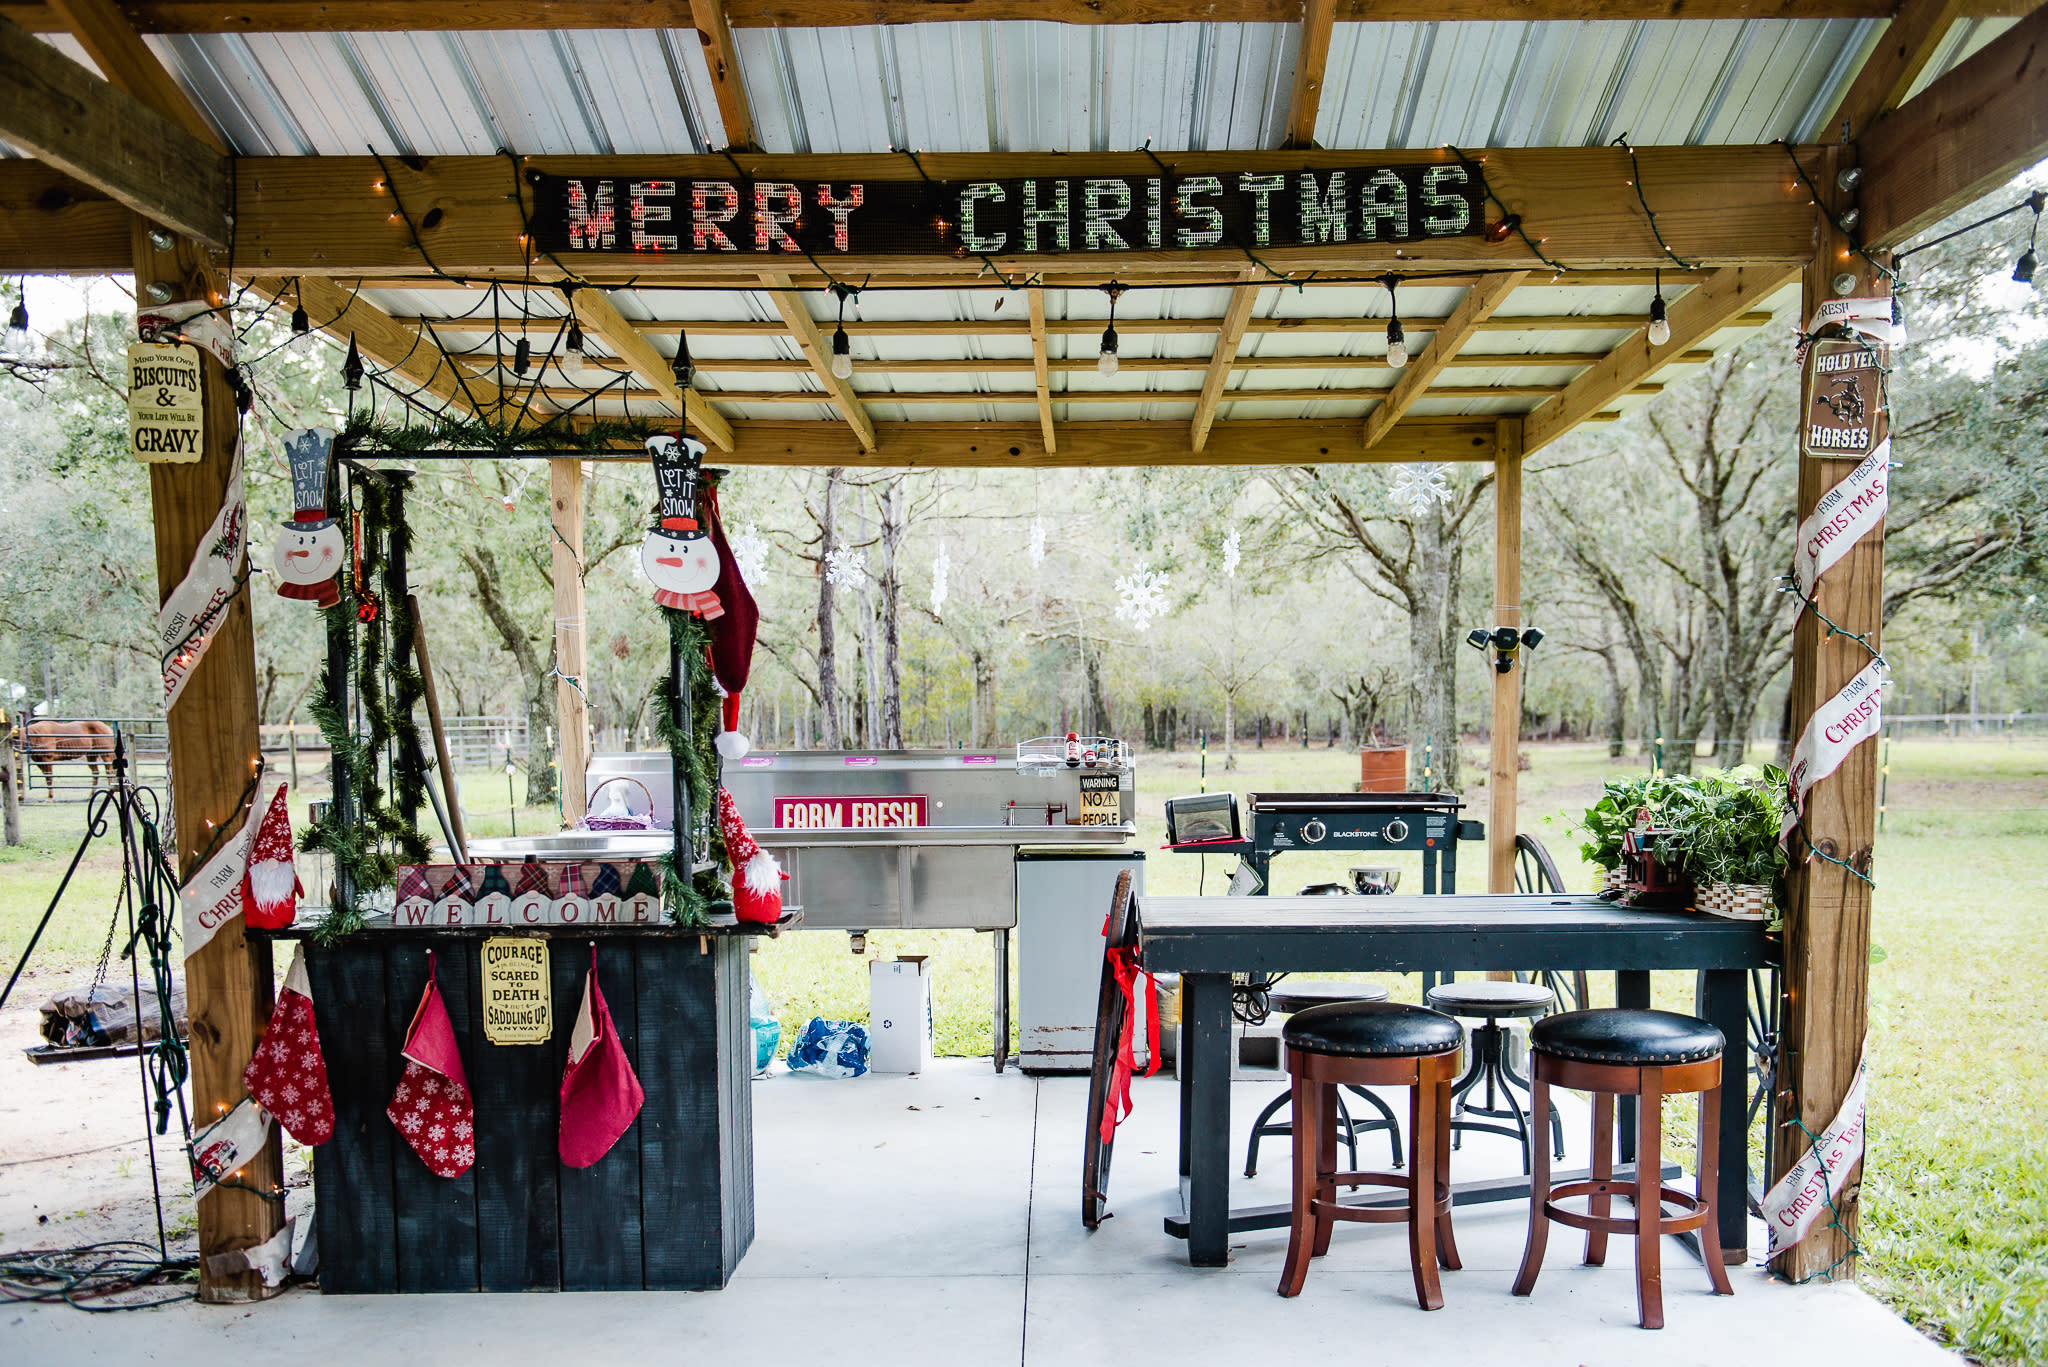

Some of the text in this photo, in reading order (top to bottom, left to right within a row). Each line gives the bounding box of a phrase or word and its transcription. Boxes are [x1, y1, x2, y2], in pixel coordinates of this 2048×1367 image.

[567, 165, 1469, 252] MERRY CHRISTMAS
[134, 354, 194, 366] MIND YOUR OWN
[1816, 353, 1850, 373] HOLD
[133, 366, 197, 393] BISCUITS
[155, 387, 177, 407] &
[138, 411, 195, 422] YOUR LIFE WILL BE
[135, 427, 200, 453] GRAVY
[1811, 424, 1869, 449] HORSES
[314, 470, 326, 488] IT
[683, 481, 695, 499] IT
[1817, 489, 1844, 516] FARM
[1848, 454, 1879, 487] FRESH
[1807, 479, 1885, 558] CHRISTMAS
[162, 611, 188, 646] FRESH
[1841, 677, 1868, 702] FARM
[1082, 777, 1117, 788] WARNING
[1083, 792, 1102, 807] NO
[782, 802, 918, 829] FARM FRESH
[1083, 812, 1117, 826] PEOPLE
[210, 864, 236, 889] FARM
[404, 901, 649, 926] WELCOME
[487, 946, 543, 965] COURAGE
[491, 971, 539, 981] SCARED
[492, 989, 540, 1001] DEATH
[488, 1005, 547, 1025] SADDLING UP
[1785, 1164, 1808, 1188] FARM
[1778, 1149, 1844, 1228] CHRISTMAS
